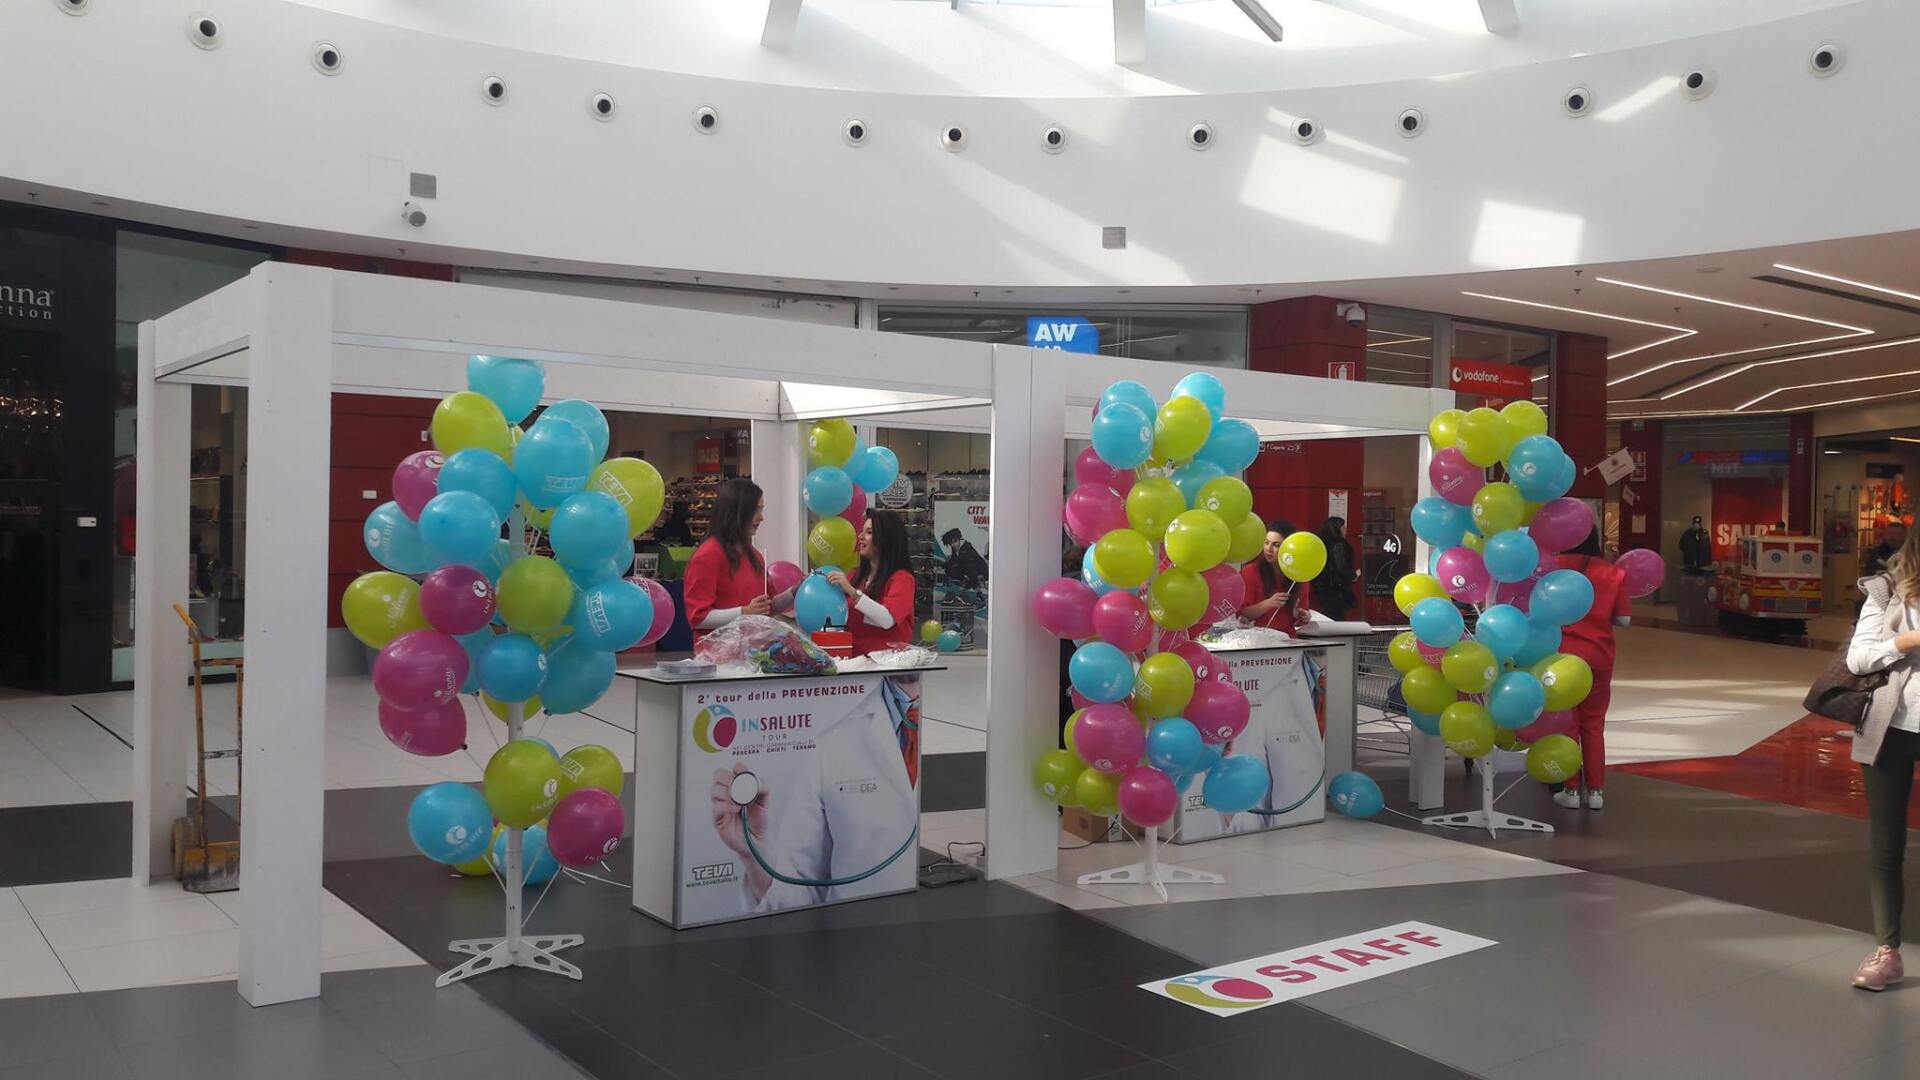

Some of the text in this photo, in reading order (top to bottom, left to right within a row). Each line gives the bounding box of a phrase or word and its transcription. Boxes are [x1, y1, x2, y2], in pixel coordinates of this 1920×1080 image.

[1034, 323, 1078, 342] AW
[1463, 370, 1500, 384] vodafone
[967, 505, 986, 515] CITY
[1717, 524, 1777, 546] SALD
[1383, 538, 1397, 553] 4G
[589, 591, 611, 634] TEVA
[1241, 657, 1292, 668] PREVENZIONE
[716, 694, 743, 703] tour
[748, 690, 777, 701] della
[782, 684, 866, 699] PREVENZIONE
[762, 733, 788, 741] TOUR
[692, 862, 734, 880] TEVA
[1255, 930, 1443, 984] STAFF
